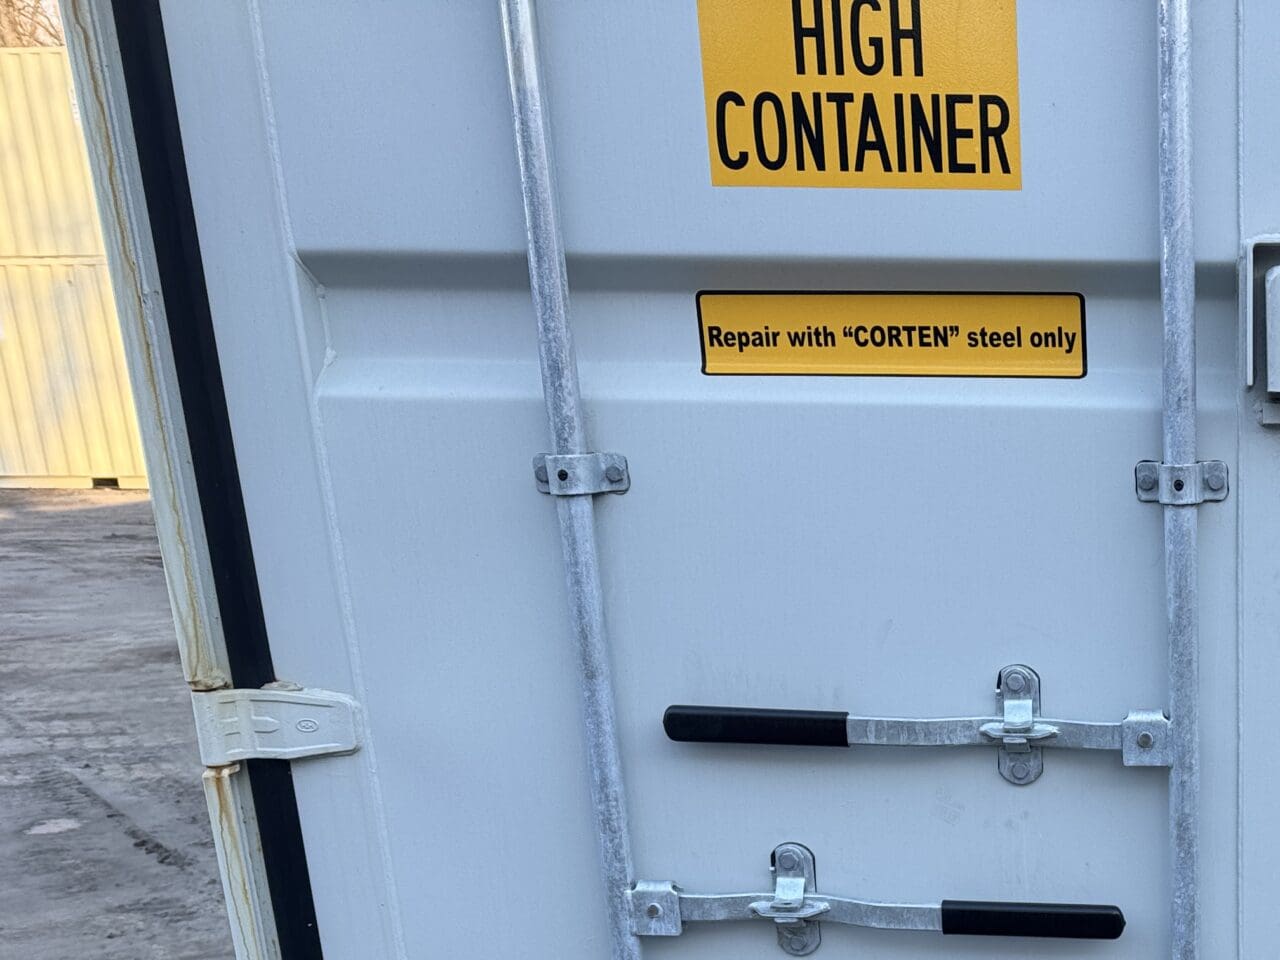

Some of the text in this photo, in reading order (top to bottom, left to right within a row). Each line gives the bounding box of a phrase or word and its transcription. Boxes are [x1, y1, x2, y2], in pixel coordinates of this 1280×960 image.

[793, 0, 924, 76] HIGH
[715, 91, 1011, 174] CONTAINER
[707, 325, 780, 352] Repair
[787, 325, 836, 348] with
[967, 327, 1022, 348] steel
[1029, 327, 1077, 354] only
